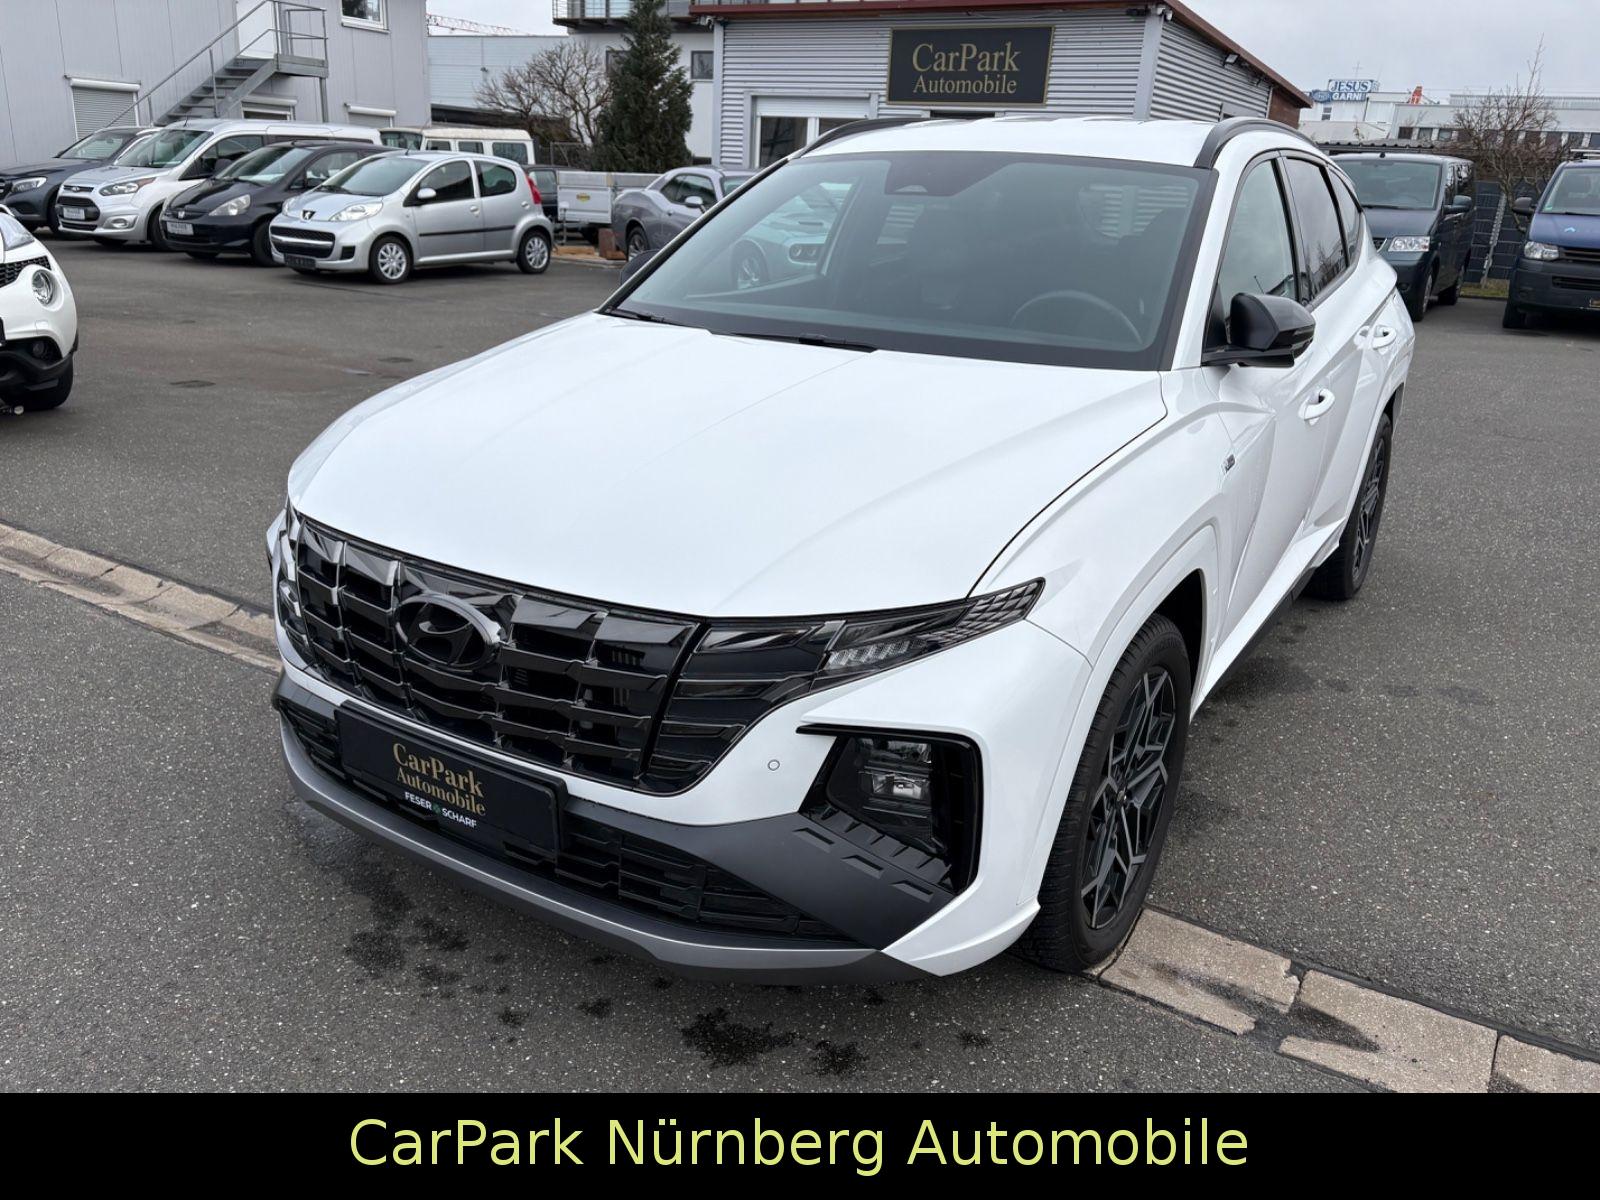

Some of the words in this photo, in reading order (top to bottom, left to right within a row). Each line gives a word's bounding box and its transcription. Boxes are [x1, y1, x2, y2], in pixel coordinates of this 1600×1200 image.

[912, 41, 1021, 72] CarPark
[913, 74, 1017, 94] Automobile
[1331, 81, 1369, 91] JESUS
[393, 743, 485, 798] CarPark
[396, 768, 486, 817] Automobile
[405, 791, 432, 811] FESER
[441, 808, 477, 829] SCHARF
